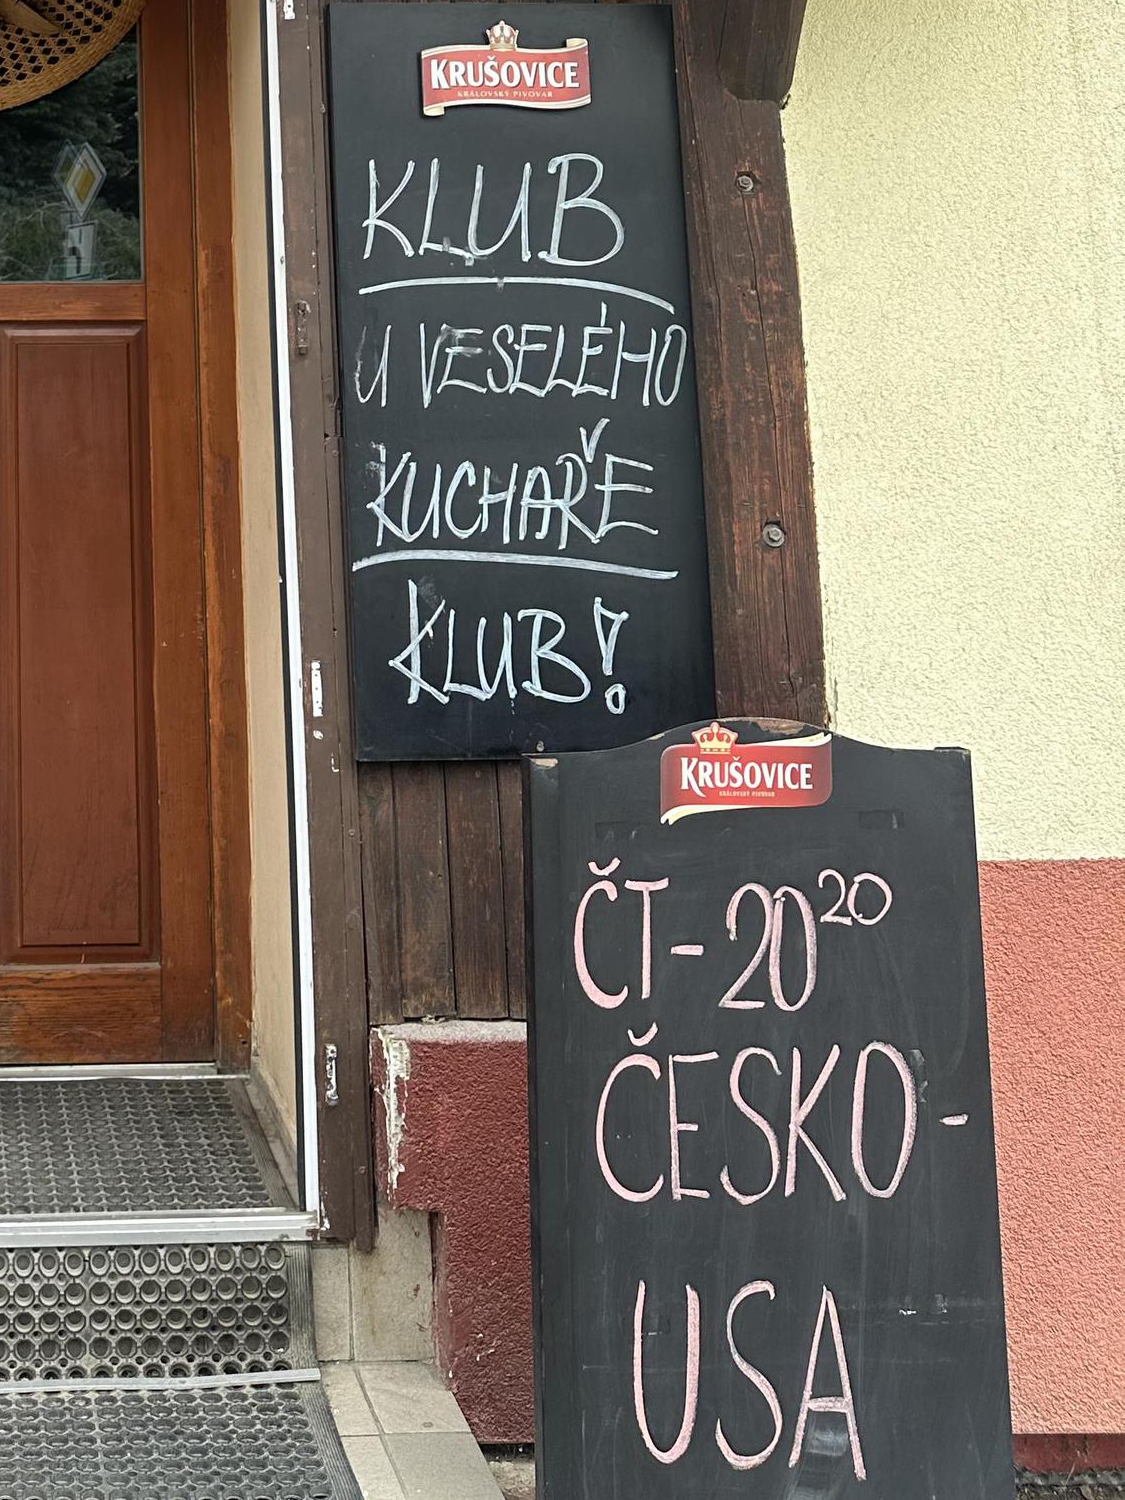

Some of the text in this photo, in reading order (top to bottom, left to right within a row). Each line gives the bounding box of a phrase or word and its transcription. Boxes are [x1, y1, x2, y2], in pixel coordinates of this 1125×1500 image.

[430, 55, 580, 90] KRUŠOVICE
[513, 90, 554, 98] PIVOVAR
[362, 153, 626, 268] KLUB
[353, 301, 687, 409] U VESELÉHO
[366, 418, 660, 550] KUCHAŘE
[388, 577, 630, 715] KLUB!
[680, 756, 814, 798] KRUŠOVICE
[632, 1278, 868, 1483] USA
